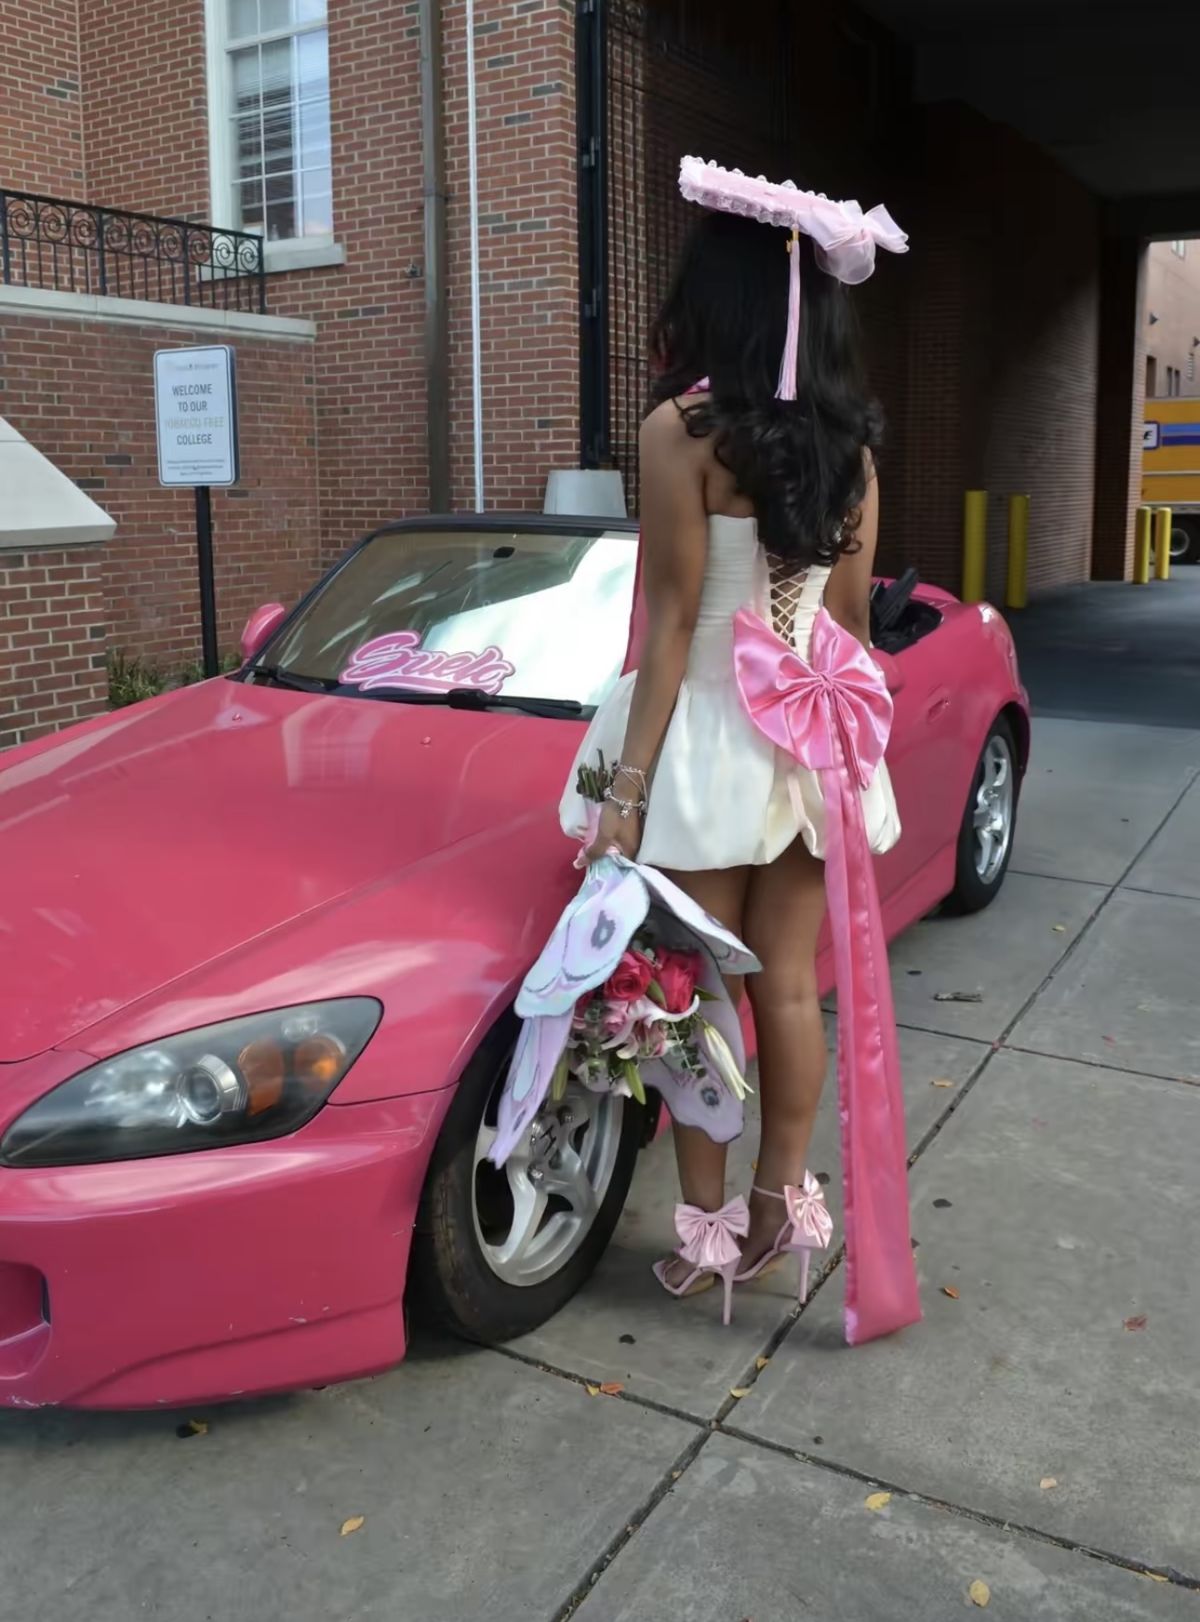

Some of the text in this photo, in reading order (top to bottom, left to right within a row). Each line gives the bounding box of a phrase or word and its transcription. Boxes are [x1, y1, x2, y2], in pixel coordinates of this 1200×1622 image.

[171, 383, 213, 396] WELCOME
[177, 400, 208, 412] TO OUR
[204, 416, 225, 427] FREE
[176, 433, 213, 445] COLLEGE
